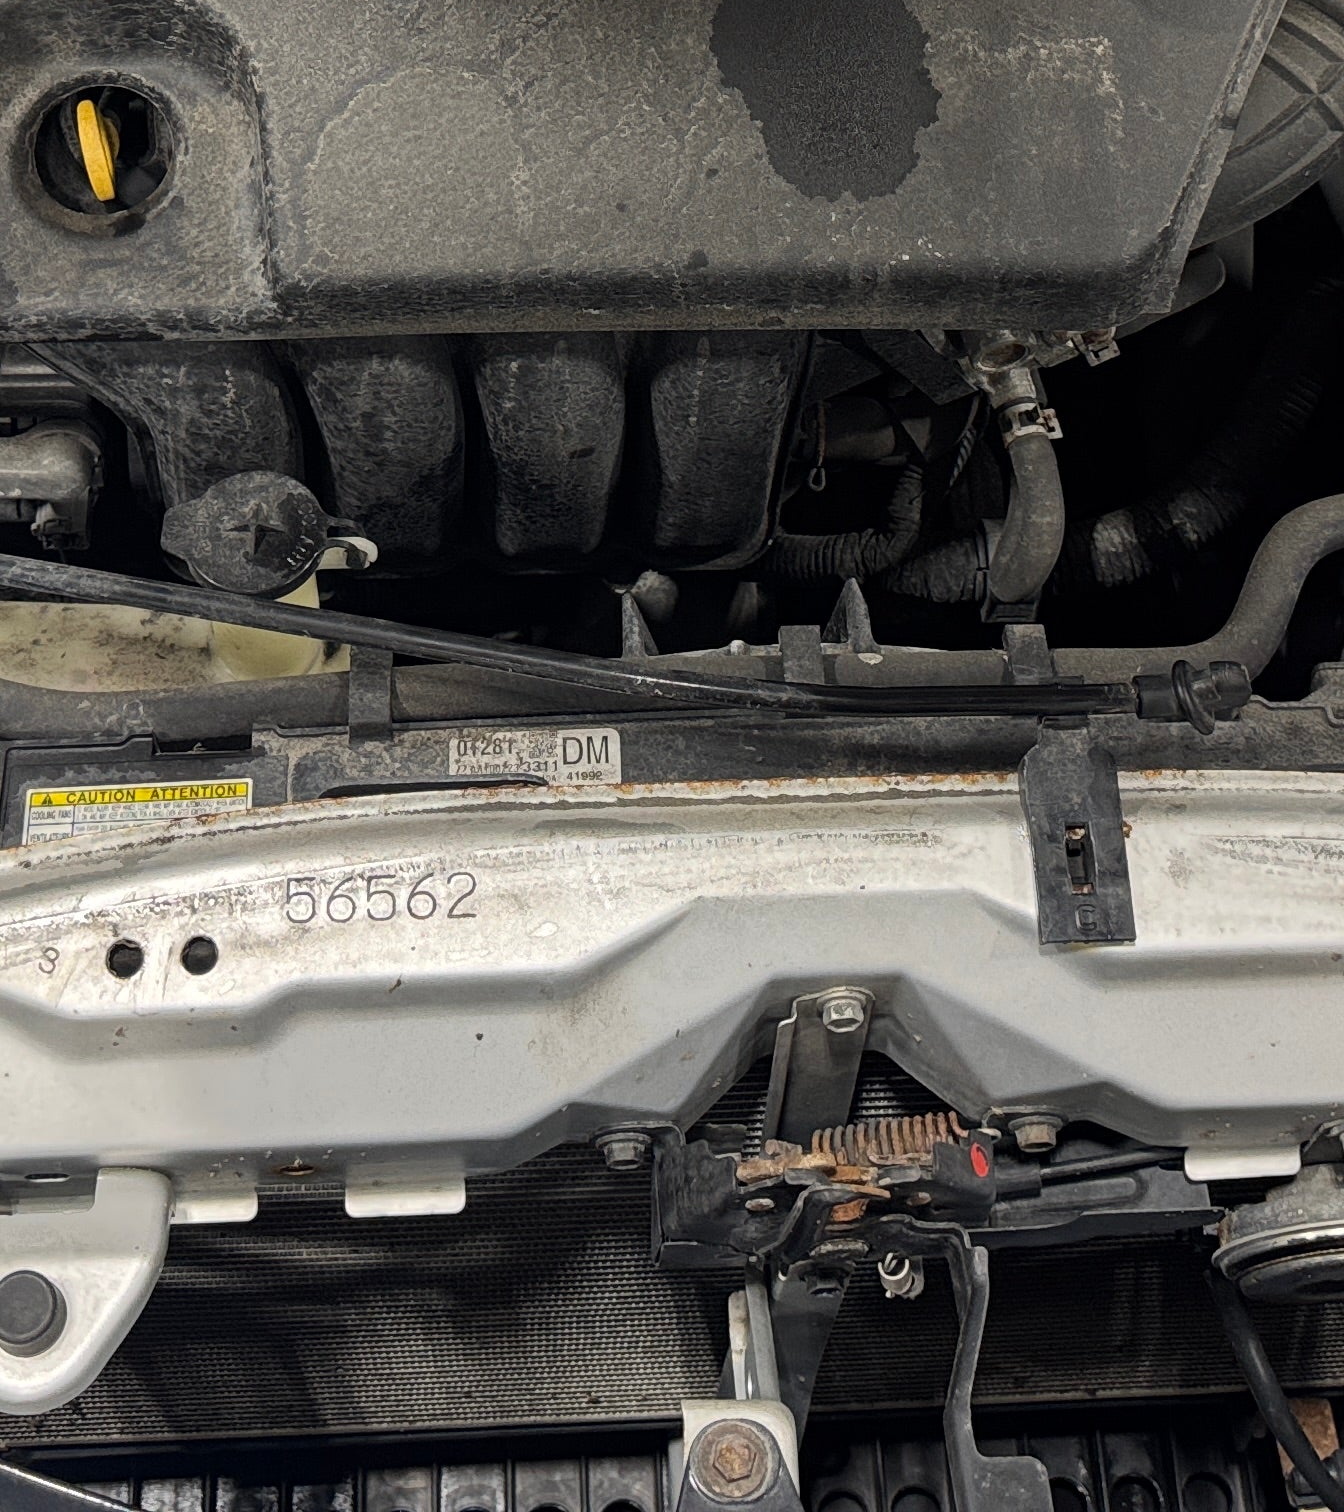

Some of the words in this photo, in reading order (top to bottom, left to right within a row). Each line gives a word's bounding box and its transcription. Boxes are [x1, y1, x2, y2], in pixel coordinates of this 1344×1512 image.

[562, 736, 609, 765] DM
[567, 770, 602, 781] 41992
[66, 789, 136, 805] CAUTION
[150, 784, 237, 800] ATTENTION
[286, 871, 477, 924] 56562
